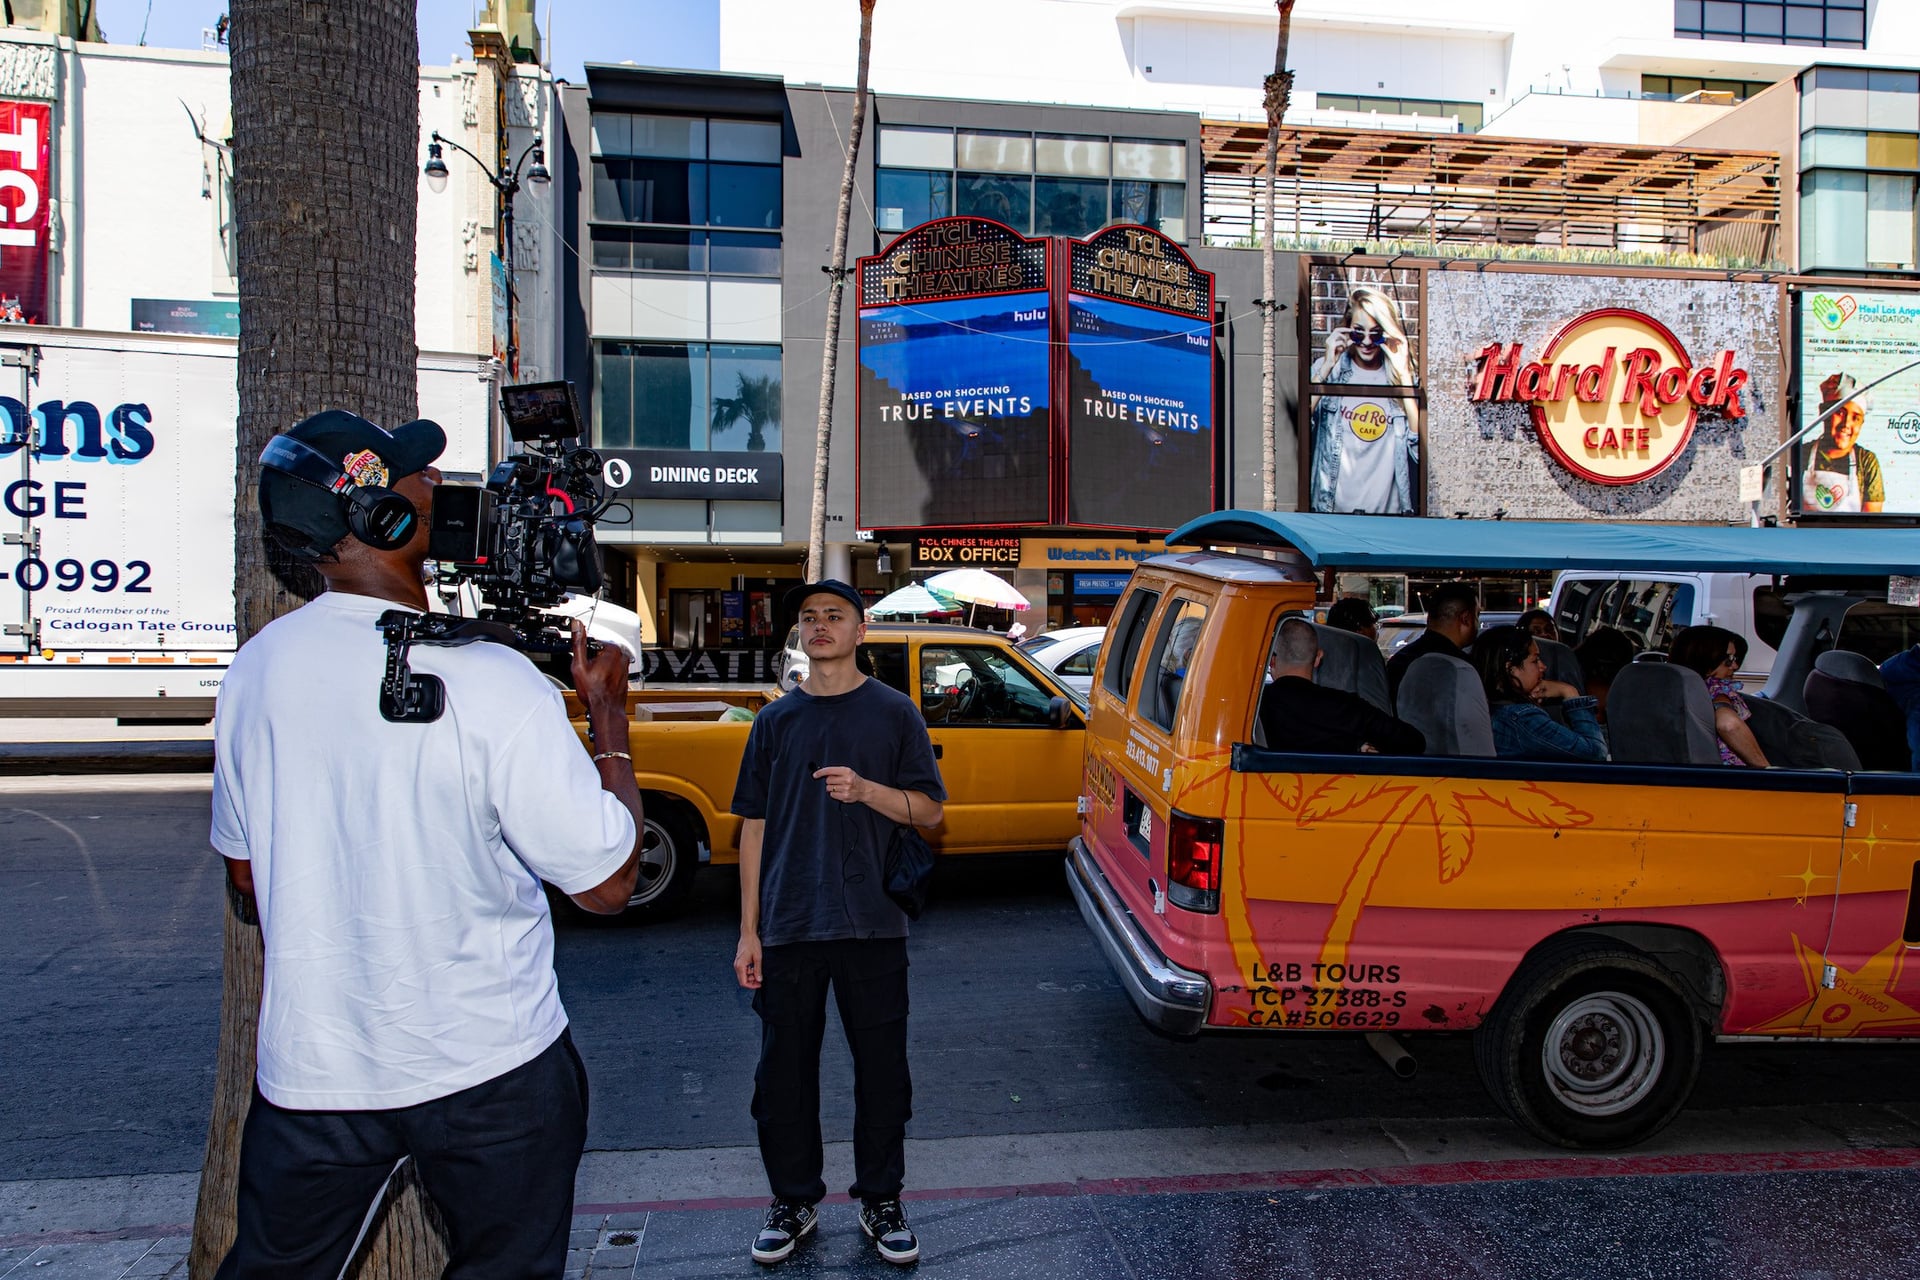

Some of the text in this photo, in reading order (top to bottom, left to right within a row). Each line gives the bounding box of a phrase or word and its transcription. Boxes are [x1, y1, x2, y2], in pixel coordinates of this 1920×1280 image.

[926, 223, 977, 247] TCL
[1125, 229, 1165, 258] TCL
[892, 242, 1011, 274] CHINESE
[1098, 248, 1189, 287] CHINESE
[881, 265, 1023, 298] THEATRES
[1088, 268, 1197, 311] THEATRES
[1014, 309, 1046, 322] hulu
[1858, 303, 1880, 314] Heal
[1881, 305, 1896, 314] Los
[1859, 313, 1913, 324] FOUNDATION
[1186, 333, 1209, 347] hulu
[1470, 342, 1749, 418] Hard Rock
[901, 385, 1010, 401] BASED ON SHOCKING
[1101, 389, 1184, 409] BASED ON SHOCKING
[880, 396, 1031, 422] TRUE EVENTS
[1083, 398, 1199, 430] TRUE EVENTS
[1370, 410, 1394, 427] Roc
[1887, 418, 1911, 430] Hard
[1359, 427, 1377, 435] CAFE
[1583, 427, 1650, 451] CAFE
[651, 467, 711, 483] DINING
[715, 468, 759, 483] DECK
[4, 480, 87, 519] GE
[856, 530, 874, 540] TCL
[919, 538, 1019, 547] TCL CHINESE THEATRES
[919, 547, 1019, 562] BOX OFFICE
[1047, 547, 1111, 561] Wetzel's
[45, 606, 81, 614] Proud
[84, 607, 133, 615] Member
[136, 607, 149, 615] of
[50, 619, 237, 633] Cadogan Tate Group
[1253, 963, 1401, 983] L&B TOURS
[1247, 989, 1407, 1008] TCP 37388-S
[1247, 1010, 1401, 1026] CA#506629
